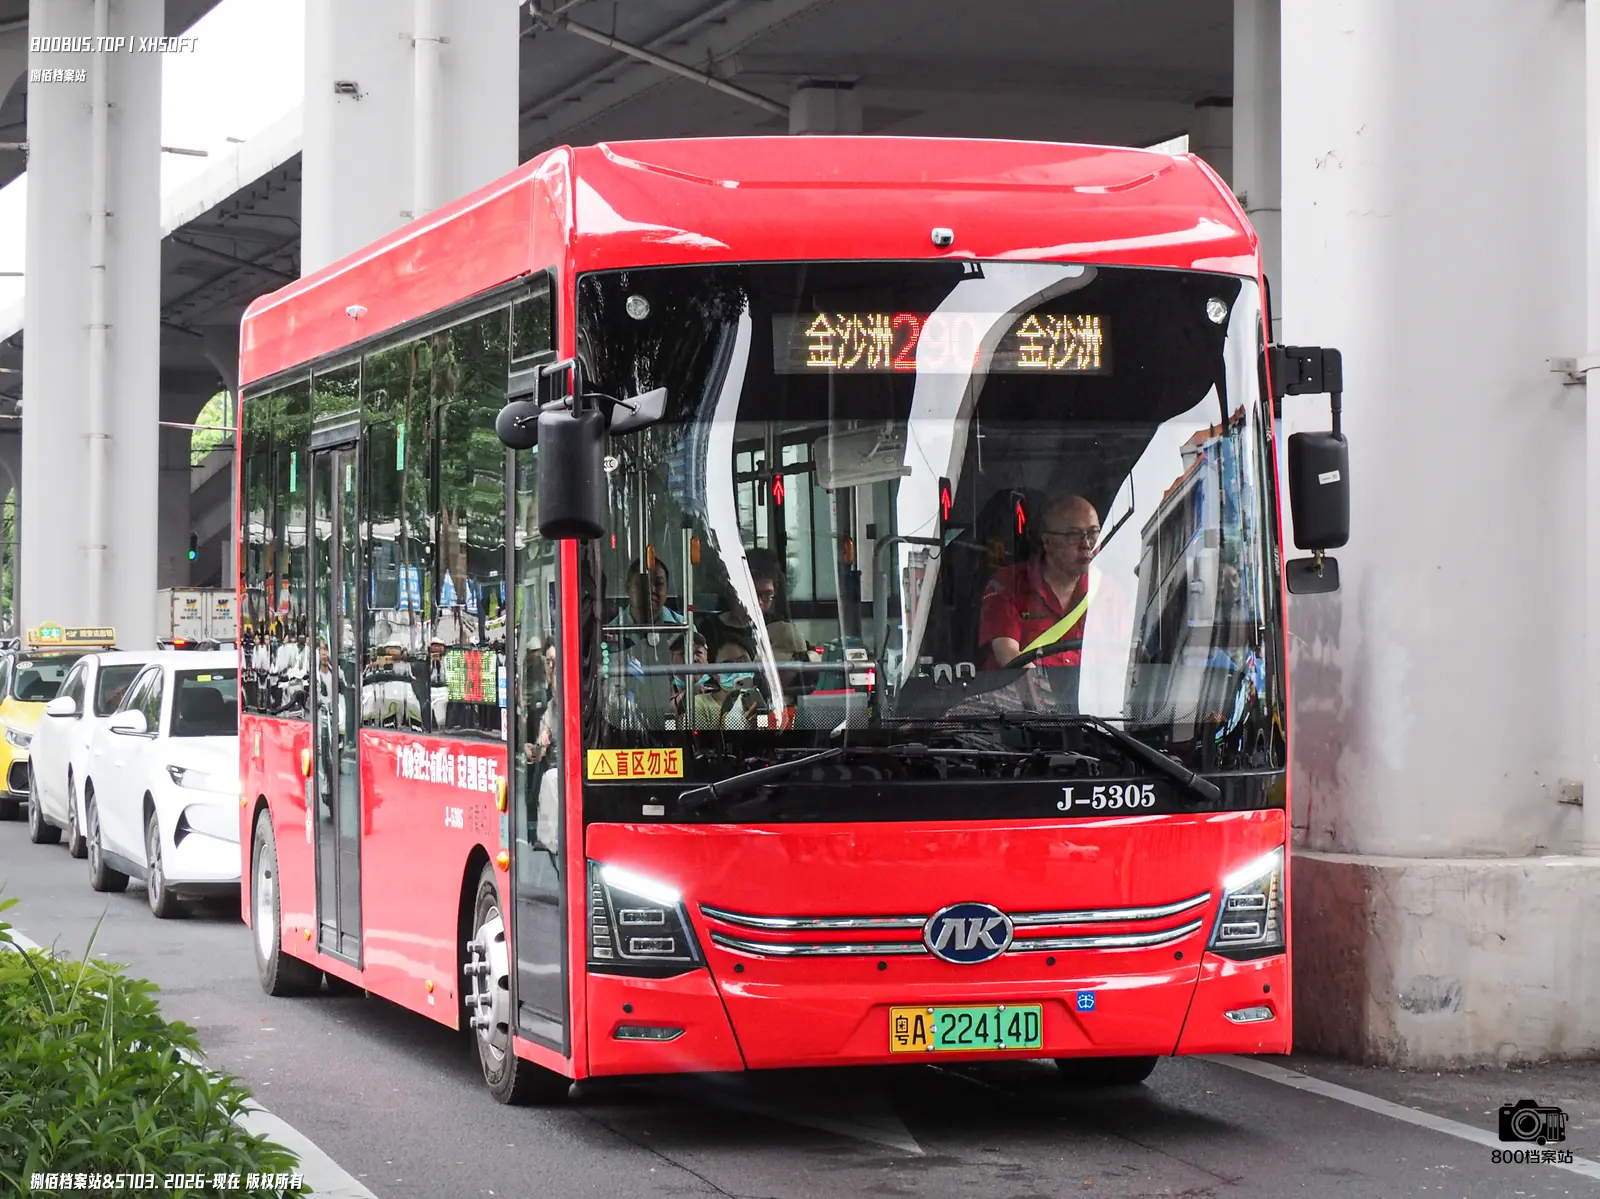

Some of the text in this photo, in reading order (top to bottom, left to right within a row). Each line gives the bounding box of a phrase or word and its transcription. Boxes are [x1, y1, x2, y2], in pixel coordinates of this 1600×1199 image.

[805, 313, 1103, 369] 金沙洲 290 金沙洲
[615, 750, 679, 776] 盲区勿近
[1056, 784, 1156, 811] J-5305
[895, 1011, 1039, 1046] 粤A 22414D
